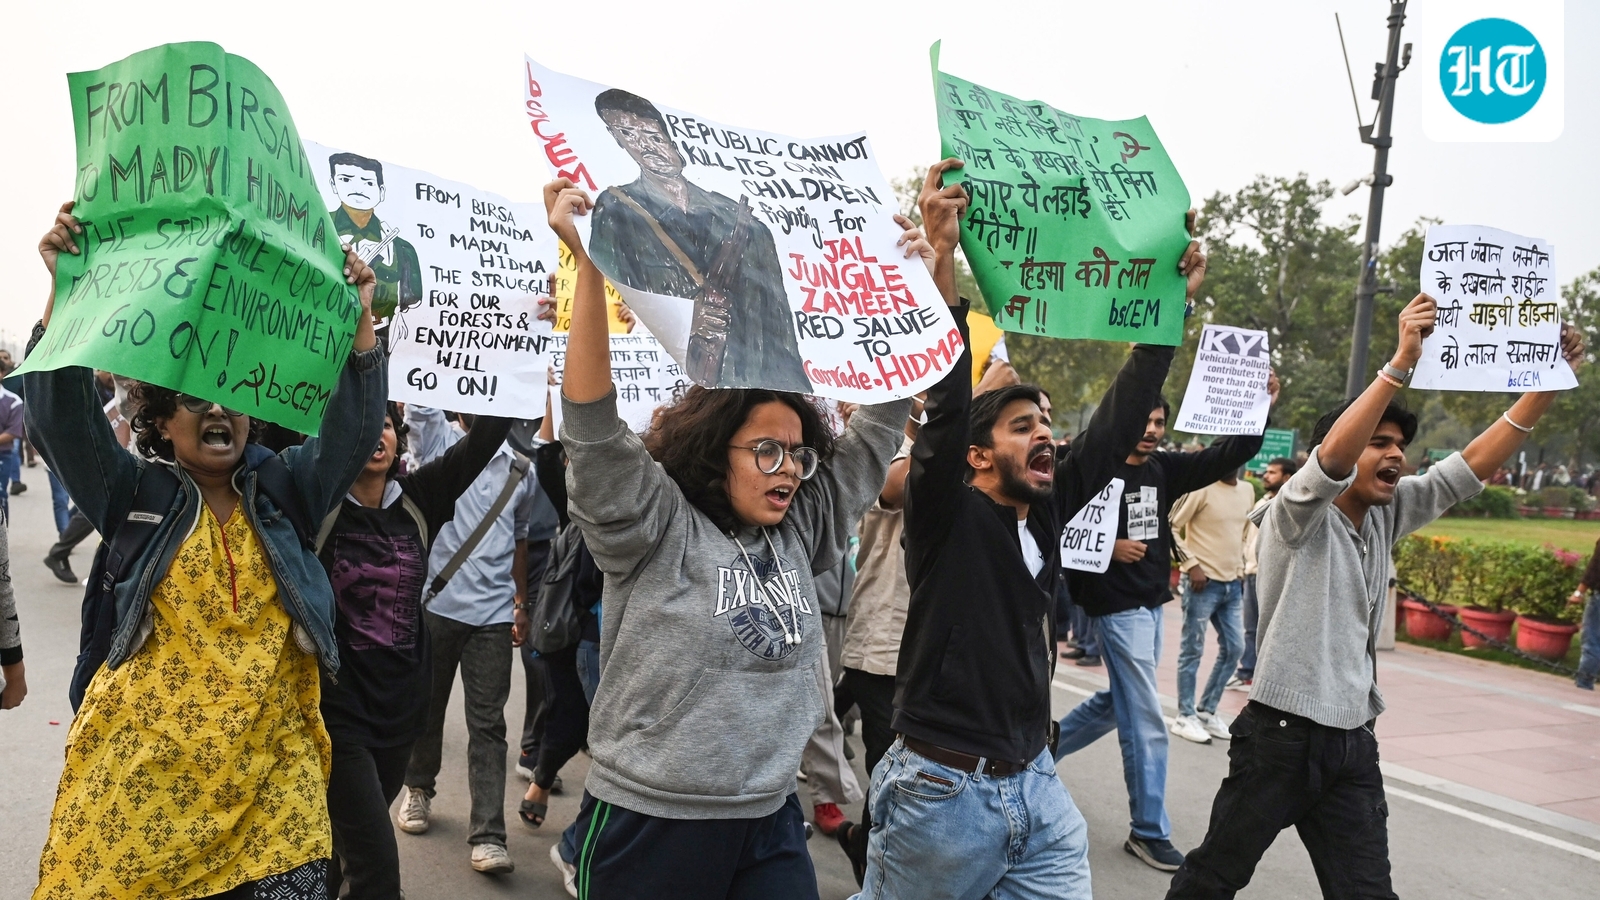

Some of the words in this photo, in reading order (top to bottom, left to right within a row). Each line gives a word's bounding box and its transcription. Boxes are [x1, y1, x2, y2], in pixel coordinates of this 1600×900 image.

[86, 72, 170, 147] FROM
[188, 64, 294, 172] BIRSA
[666, 113, 782, 157] REPUBLIC
[787, 136, 867, 163] CANNOT
[681, 140, 735, 171] KILL
[734, 156, 776, 177] ITS
[783, 161, 844, 181] OWN
[741, 178, 882, 205] CHILDREN
[1017, 171, 1040, 213] ये
[1111, 163, 1159, 199] बिना
[76, 162, 99, 206] TO
[247, 156, 327, 254] HIDMA
[416, 182, 461, 209] FROM
[471, 198, 516, 226] BIRSA
[470, 216, 534, 241] MUNDA
[829, 209, 866, 234] for
[417, 223, 434, 239] TO
[450, 233, 509, 255] MADVI
[823, 236, 878, 264] JAL
[79, 216, 136, 265] THE
[272, 241, 325, 308] FOR
[480, 253, 546, 274] HIDMA
[1075, 246, 1119, 289] को
[1117, 258, 1157, 290] लाल
[1428, 241, 1469, 262] जल
[1513, 244, 1550, 268] जमीन
[430, 265, 462, 284] THE
[788, 252, 908, 292] JUNGLE
[1436, 270, 1452, 295] के
[1460, 268, 1506, 296] रखवाले
[1511, 271, 1548, 298] शहीद
[430, 289, 458, 309] FOR
[470, 293, 500, 310] OUR
[800, 286, 919, 316] ZAMEEN
[60, 257, 162, 316] FORESTS
[163, 257, 199, 299] &
[202, 262, 354, 374] ENVIRONMENT
[439, 310, 513, 329] FORESTS
[517, 312, 529, 331] &
[794, 311, 845, 340] RED
[853, 306, 940, 338] SALUTE
[39, 316, 97, 362] WILL
[102, 303, 156, 347] GO
[415, 327, 552, 355] ENVIRONMENT
[437, 350, 485, 373] WILL
[853, 339, 892, 363] TO
[874, 327, 964, 391] HIDMA
[1200, 352, 1238, 365] Vehicular
[1441, 335, 1459, 370] को
[1464, 344, 1498, 367] लाल
[1506, 340, 1559, 369] सलाम!
[407, 367, 437, 391] GO
[457, 375, 497, 402] ON!
[1202, 375, 1224, 384] more
[1226, 377, 1246, 387] than
[1247, 380, 1266, 391] 40%
[1207, 365, 1255, 378] contributes
[1257, 371, 1266, 380] to
[1208, 385, 1242, 397] towards
[1243, 390, 1256, 399] Air
[1184, 421, 1218, 432] PRIVATE
[1192, 413, 1242, 426] REGULATION
[1210, 406, 1230, 416] WHY
[1231, 409, 1243, 418] NO
[1082, 503, 1106, 525] ITS
[731, 610, 766, 651] WITH
